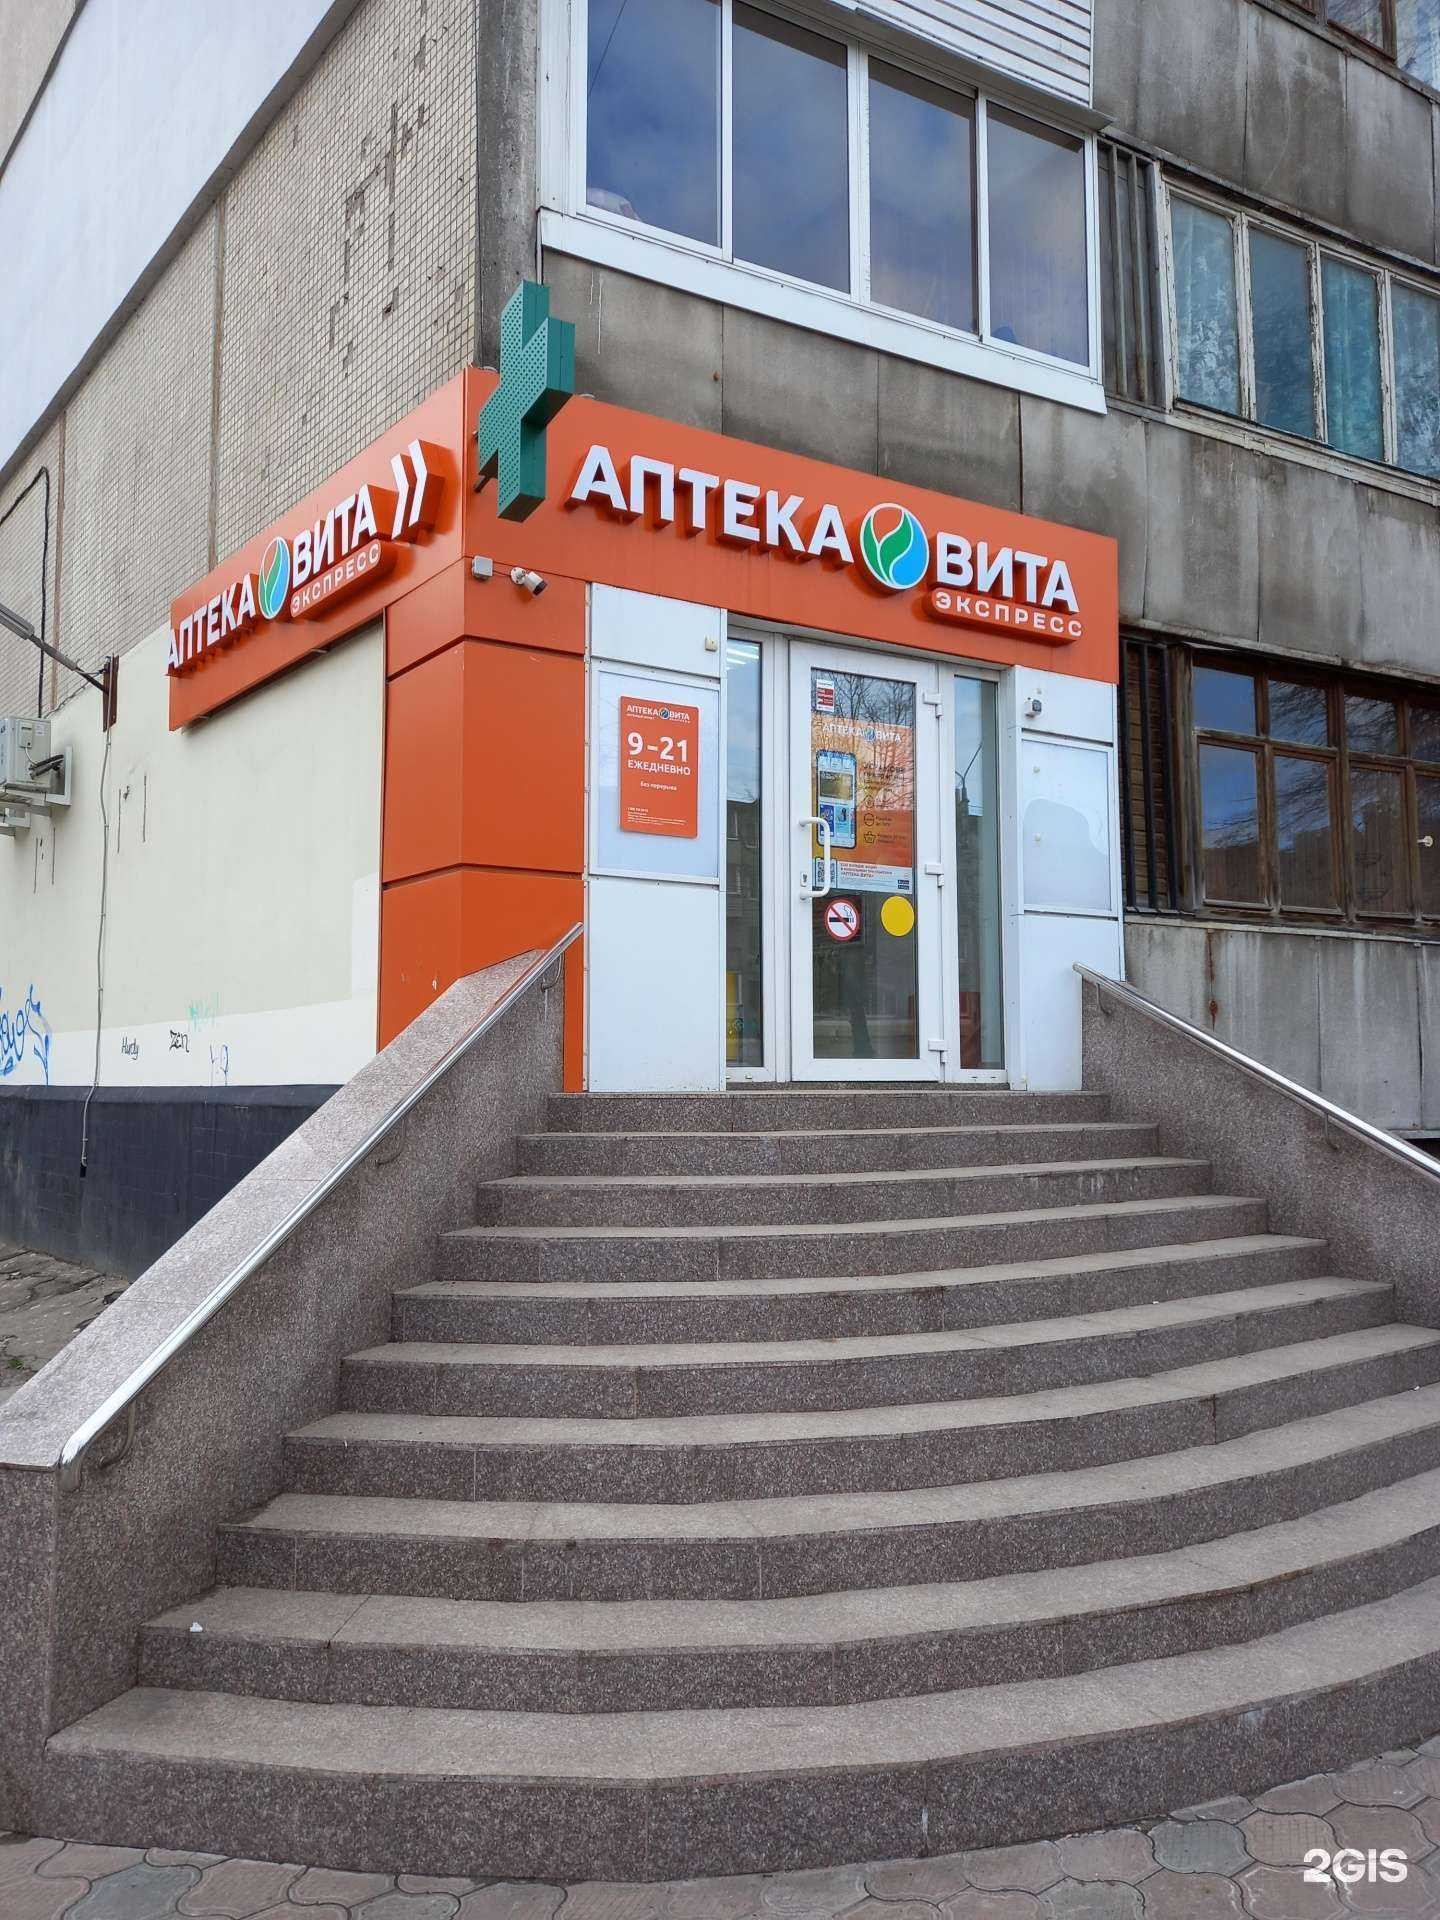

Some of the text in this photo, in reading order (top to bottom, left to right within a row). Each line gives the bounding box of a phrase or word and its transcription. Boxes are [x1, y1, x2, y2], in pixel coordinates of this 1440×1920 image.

[571, 445, 1080, 614] АПТЕКА ВИТА
[168, 484, 377, 669] АПТЕКА ВИТА
[291, 543, 381, 614] ЭКСПРЕСС
[934, 590, 1084, 638] ЭКСПРЕСС
[626, 704, 660, 717] АПТЕКА
[670, 711, 690, 721] ВИТА
[822, 723, 901, 742] АПТЕКА ВИТА
[627, 759, 691, 776] ЕЖЕДНЕВНО
